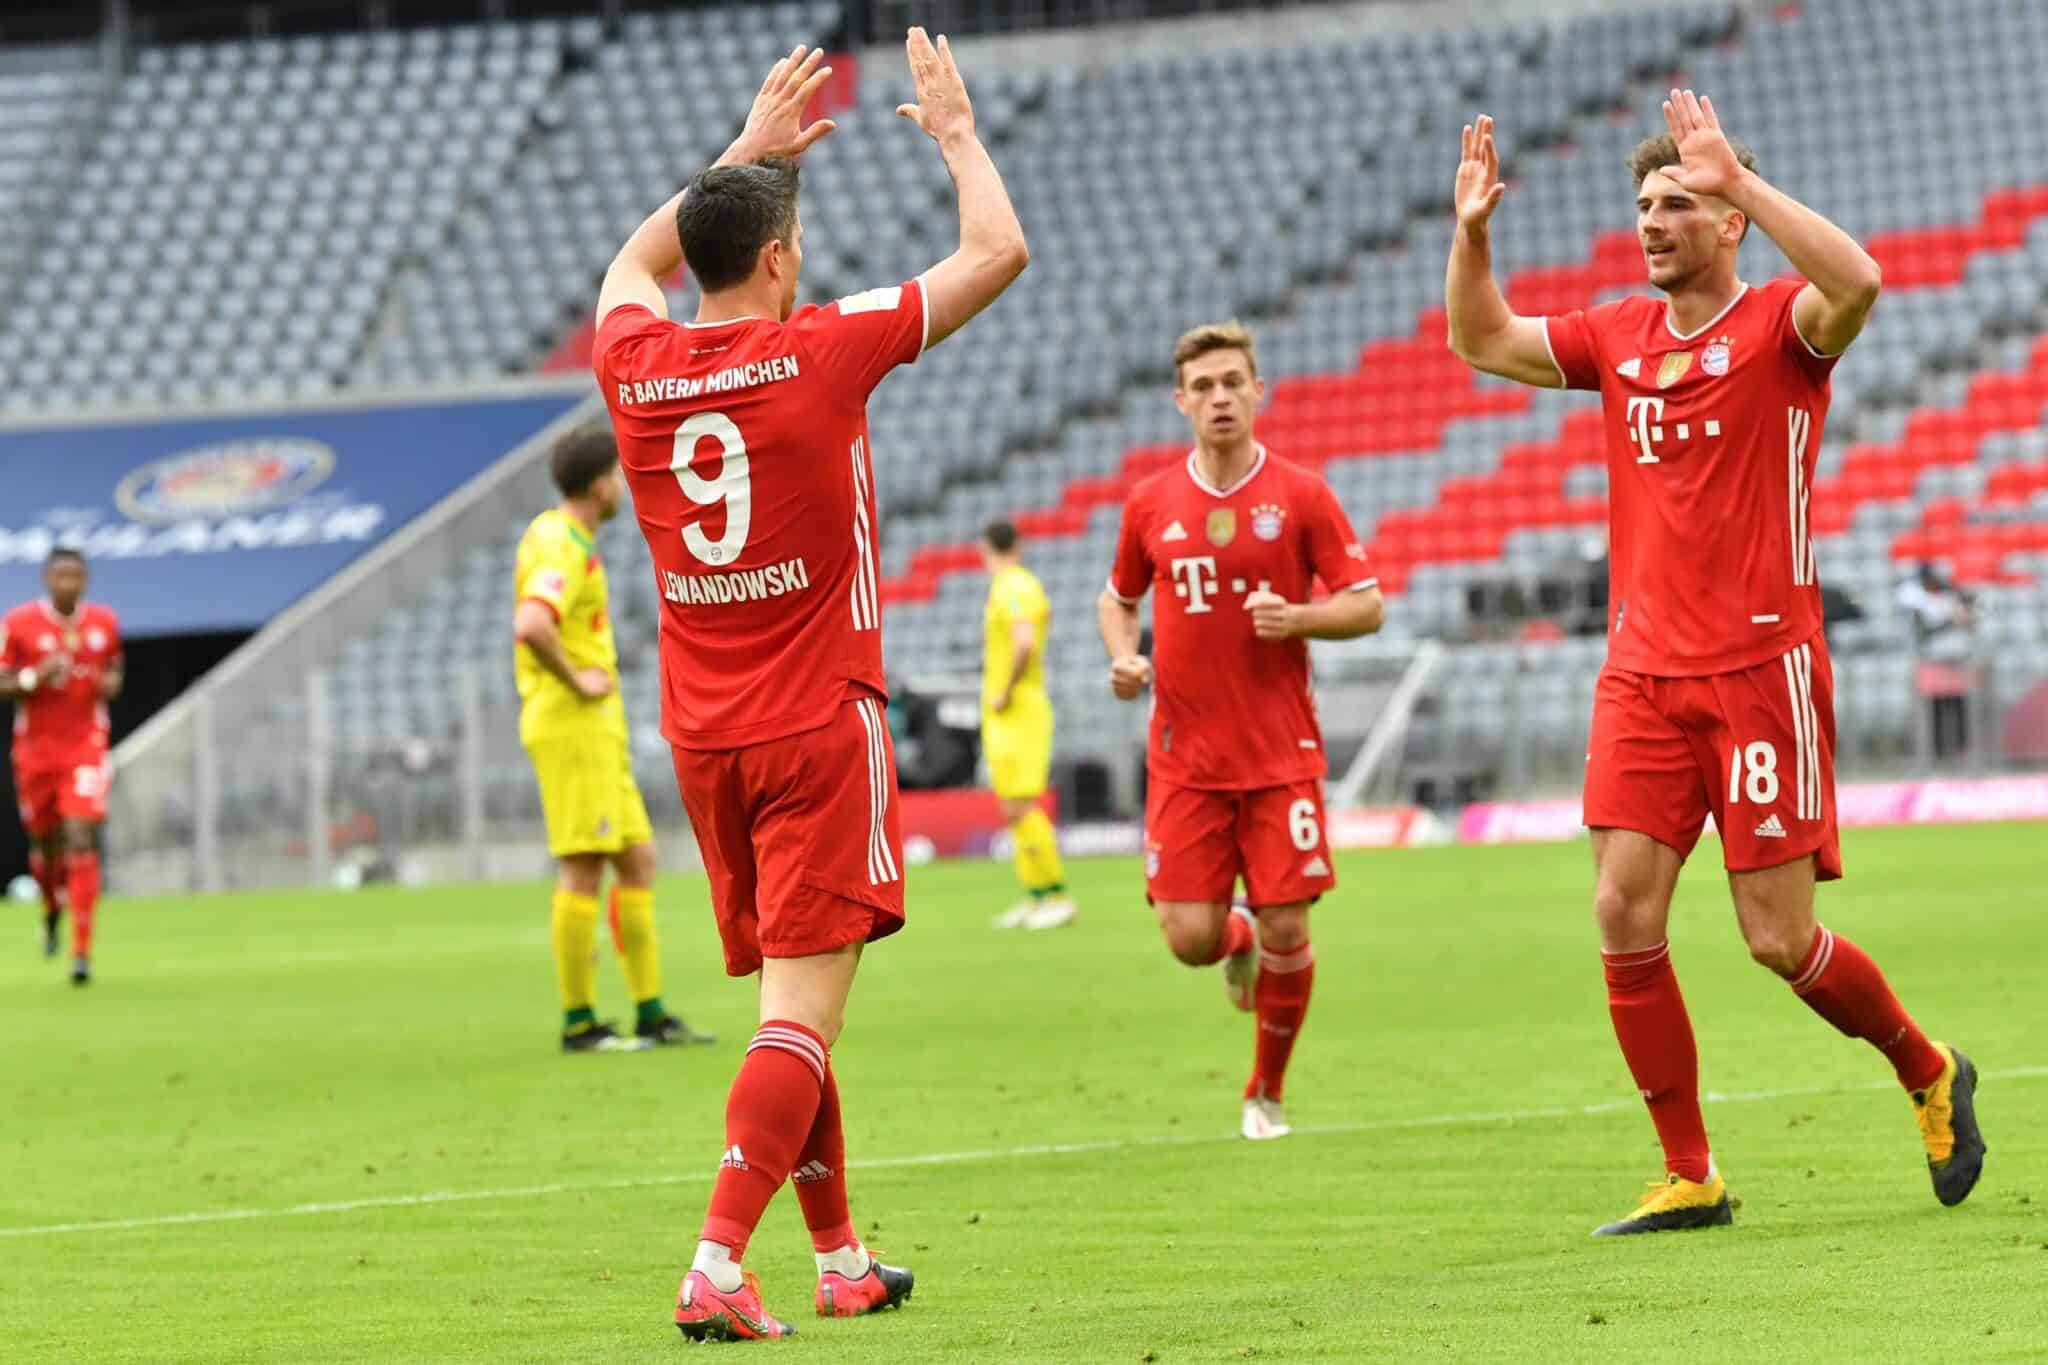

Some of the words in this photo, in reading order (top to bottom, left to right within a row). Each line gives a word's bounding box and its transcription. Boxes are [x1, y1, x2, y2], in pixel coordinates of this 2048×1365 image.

[617, 383, 634, 406] FC
[634, 378, 704, 404] BAYERN
[669, 411, 752, 567] 9
[662, 557, 810, 605] LEWANDOWSKI
[1729, 740, 1779, 805] 18
[1288, 797, 1320, 852] 6
